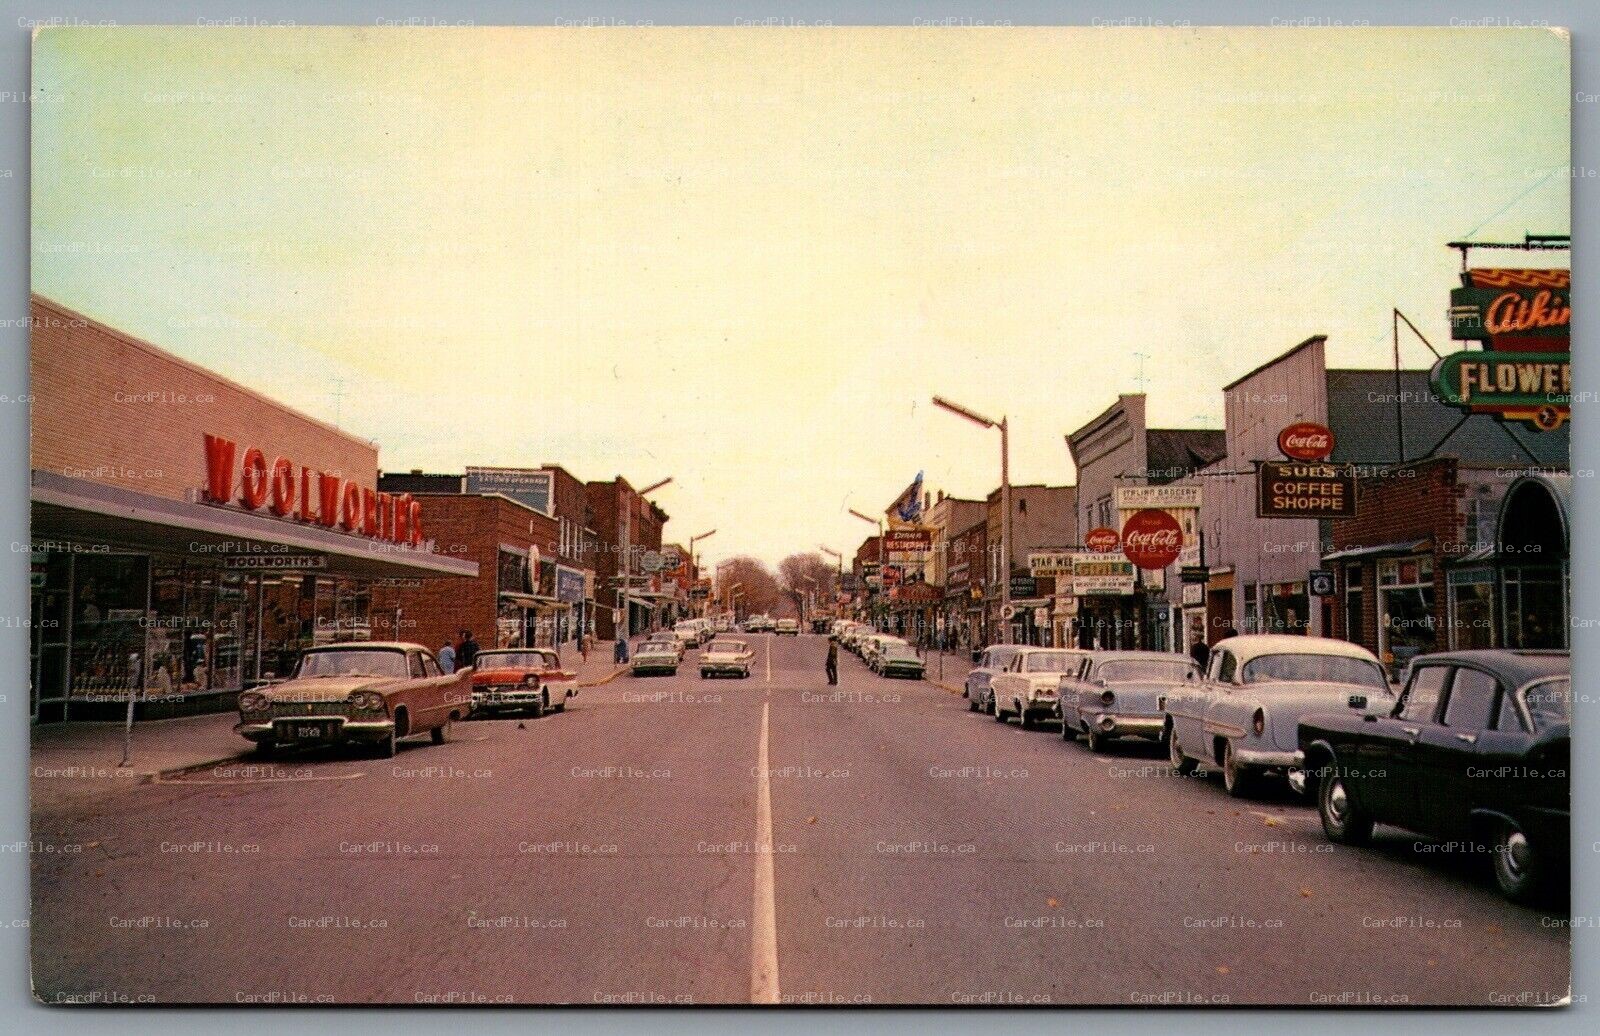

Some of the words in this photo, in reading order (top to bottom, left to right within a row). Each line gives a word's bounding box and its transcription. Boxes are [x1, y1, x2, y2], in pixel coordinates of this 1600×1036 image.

[1273, 482, 1344, 496] COFFEE
[1273, 496, 1344, 510] SHOPPE
[1127, 529, 1179, 547] Coca-Cola
[1031, 557, 1052, 567] STAR
